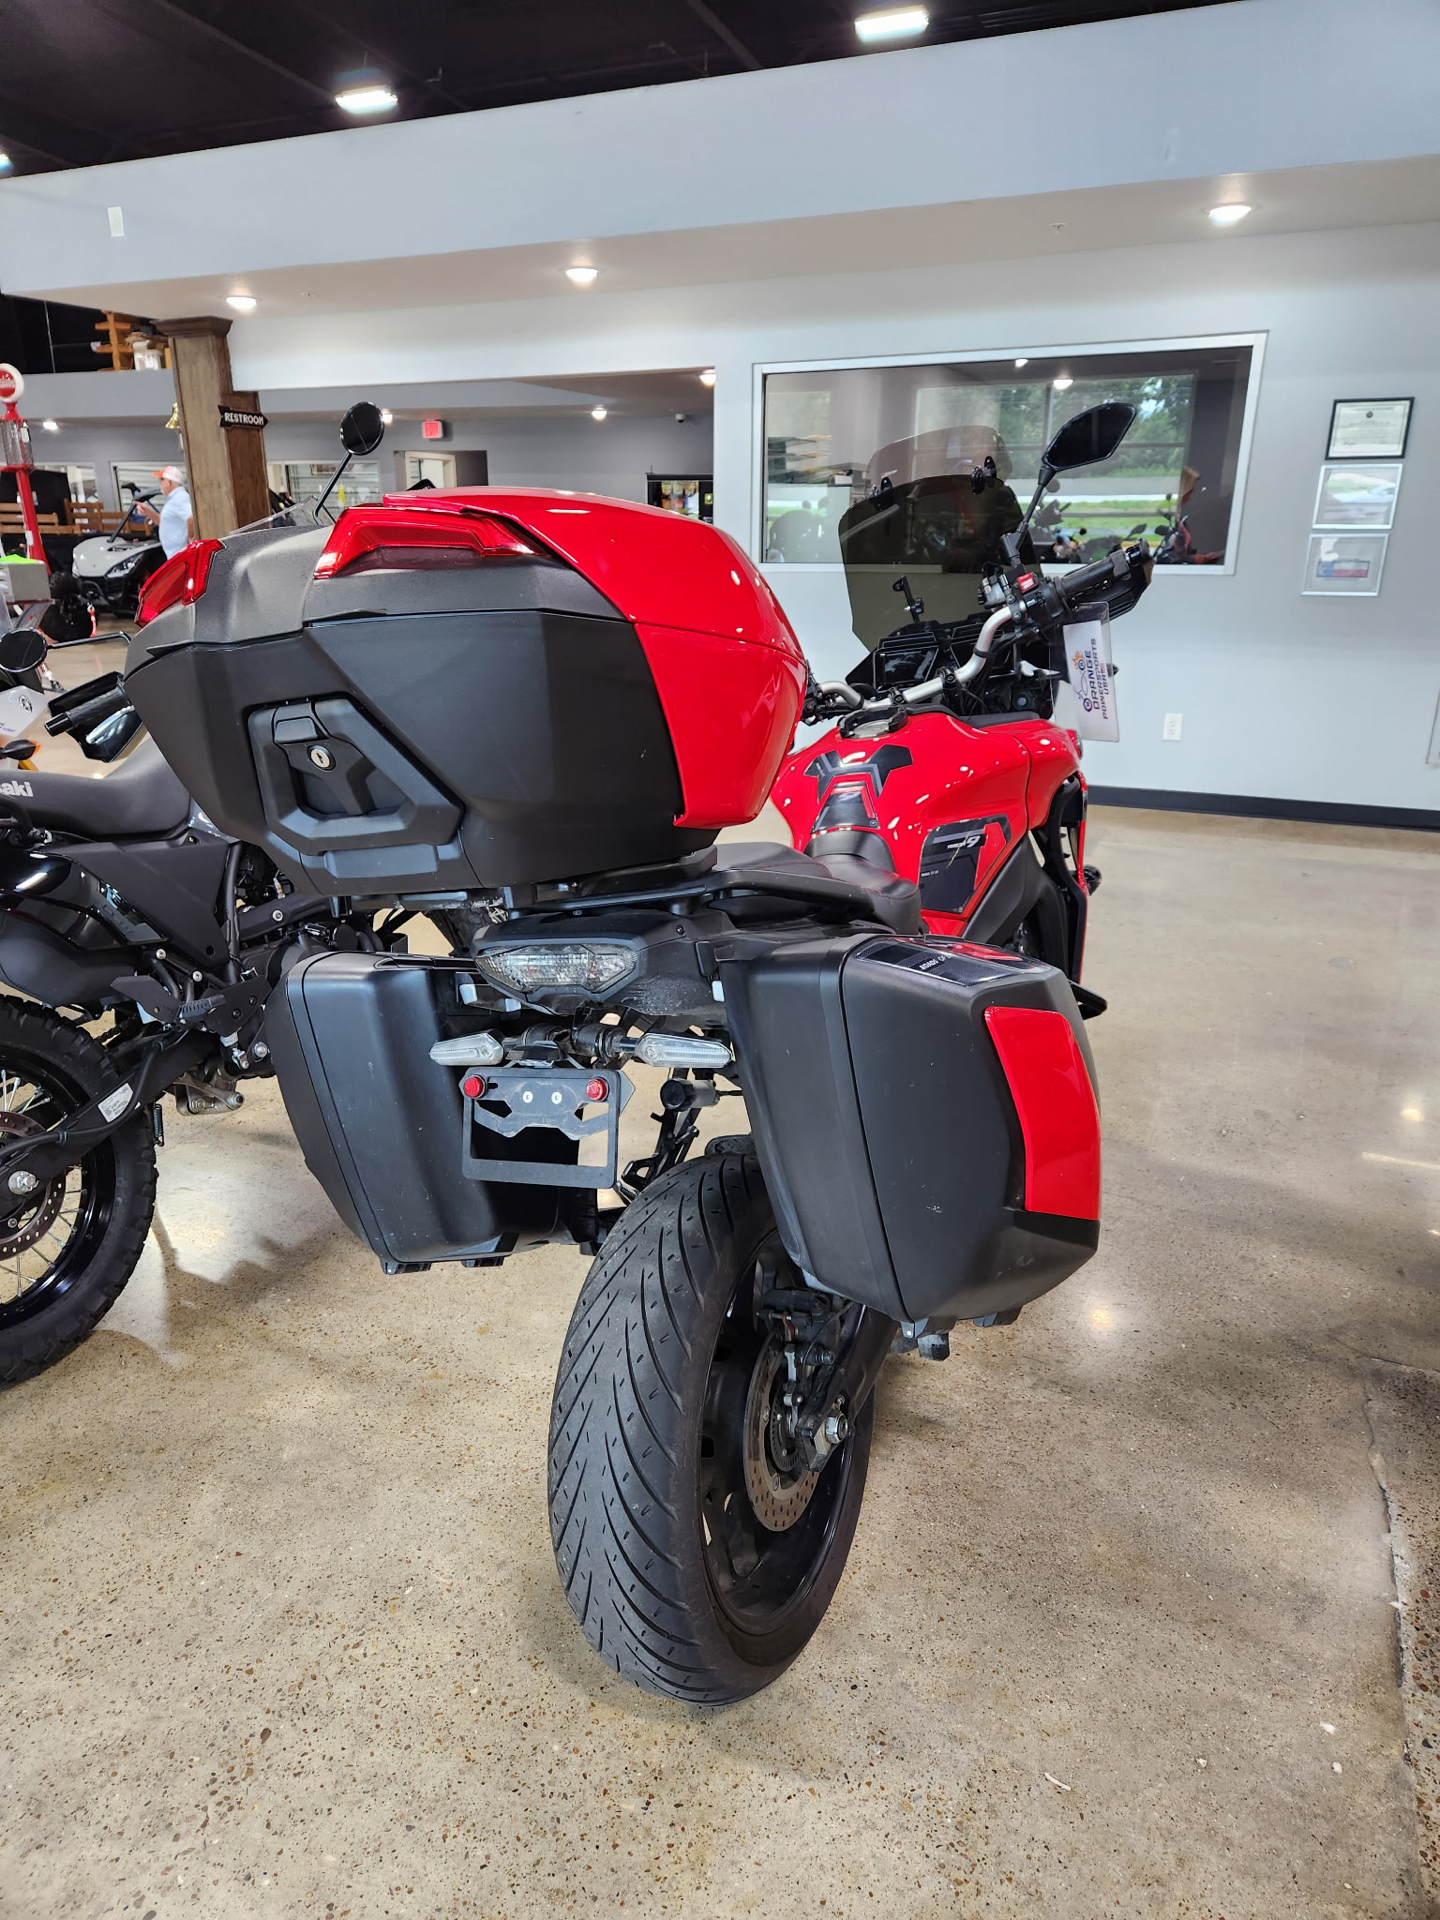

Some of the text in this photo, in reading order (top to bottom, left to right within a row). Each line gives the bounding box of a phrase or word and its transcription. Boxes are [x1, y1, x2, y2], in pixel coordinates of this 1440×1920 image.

[224, 412, 264, 425] RESTROOM
[1085, 650, 1100, 710] ORANGE
[1091, 638, 1108, 720] POWERSPORTS
